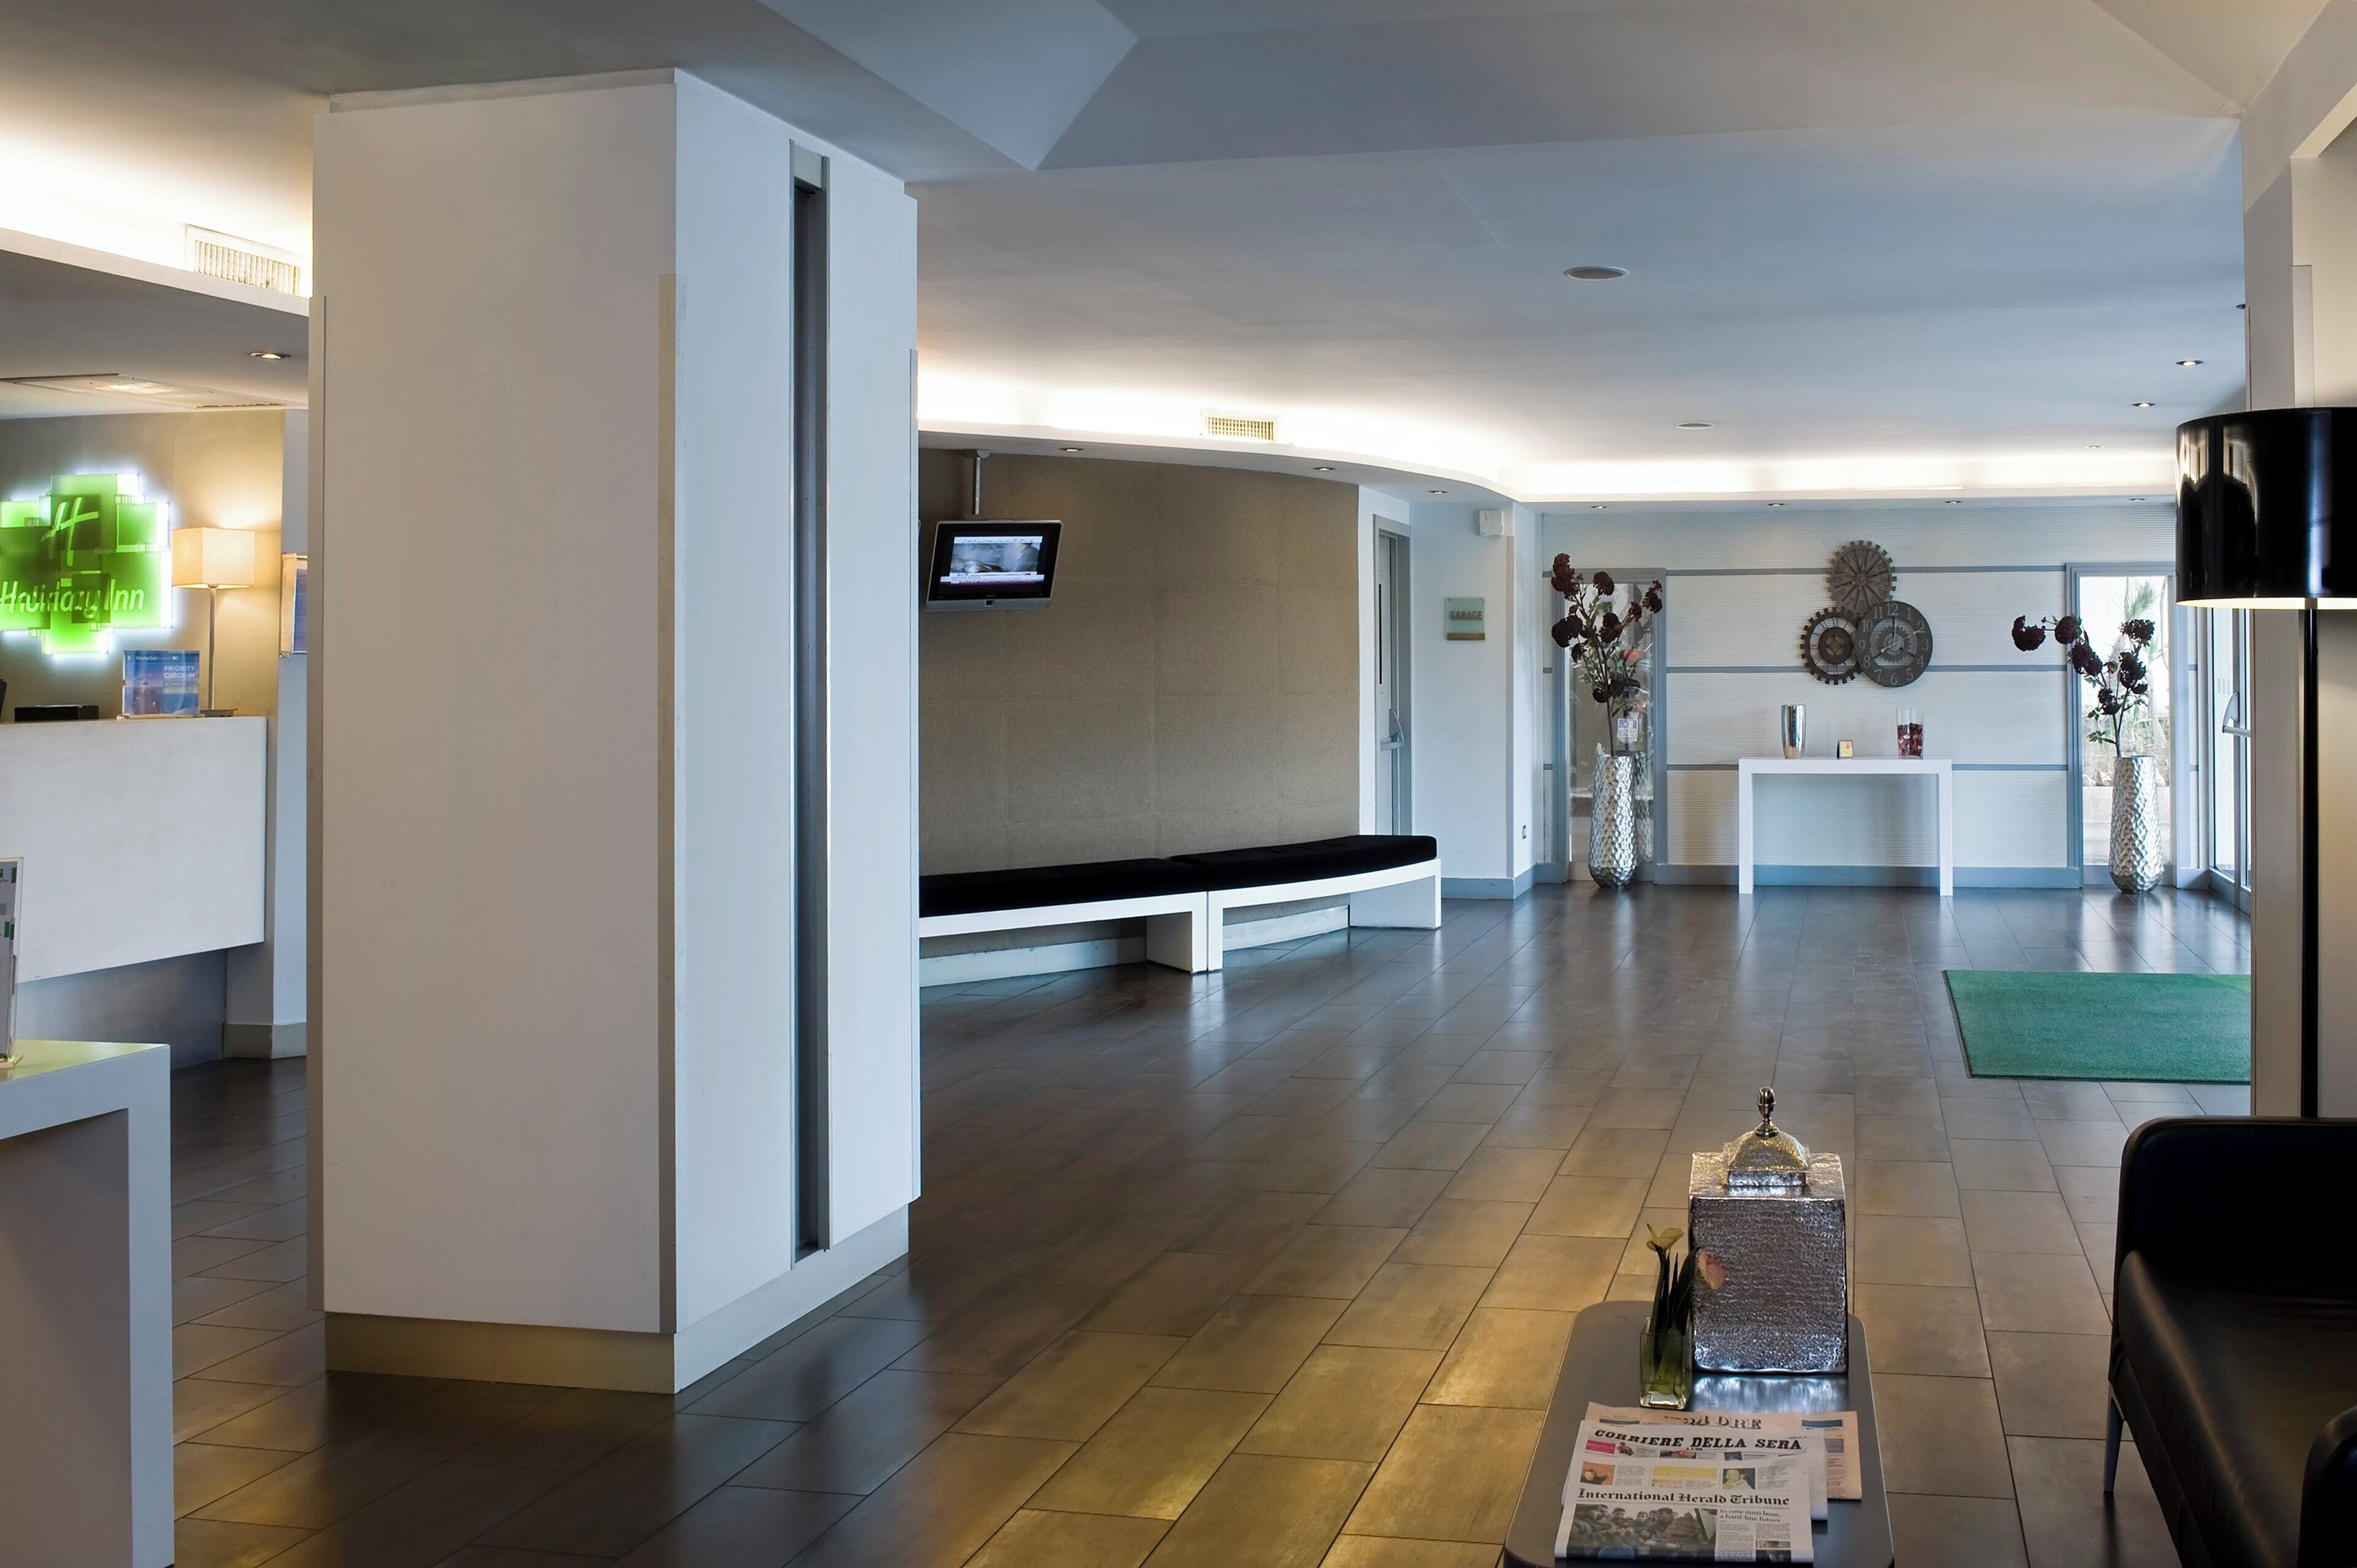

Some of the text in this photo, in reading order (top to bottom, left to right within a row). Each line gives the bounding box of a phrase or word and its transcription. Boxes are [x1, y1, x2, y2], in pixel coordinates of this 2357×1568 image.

[0, 579, 145, 619] Holiday Inn
[1450, 610, 1483, 620] GARAGE
[1873, 606, 1884, 619] 11
[1886, 603, 1899, 616] 12
[1906, 607, 1912, 620] 1
[1861, 619, 1873, 633] 10
[1917, 620, 1925, 633] 2
[1858, 639, 1865, 652] 9
[1921, 638, 1929, 651] 3
[1863, 655, 1871, 668] 8
[1916, 655, 1925, 668] 4
[1874, 668, 1883, 682] 7
[1891, 672, 1898, 686] 6
[1906, 668, 1913, 681] 5
[1713, 1416, 1762, 1430] ORE
[1594, 1429, 1684, 1448] CORRIERE
[1690, 1437, 1747, 1449] DELLA
[1754, 1438, 1802, 1450] SERA
[1577, 1488, 1790, 1505] International Herald Tribune
